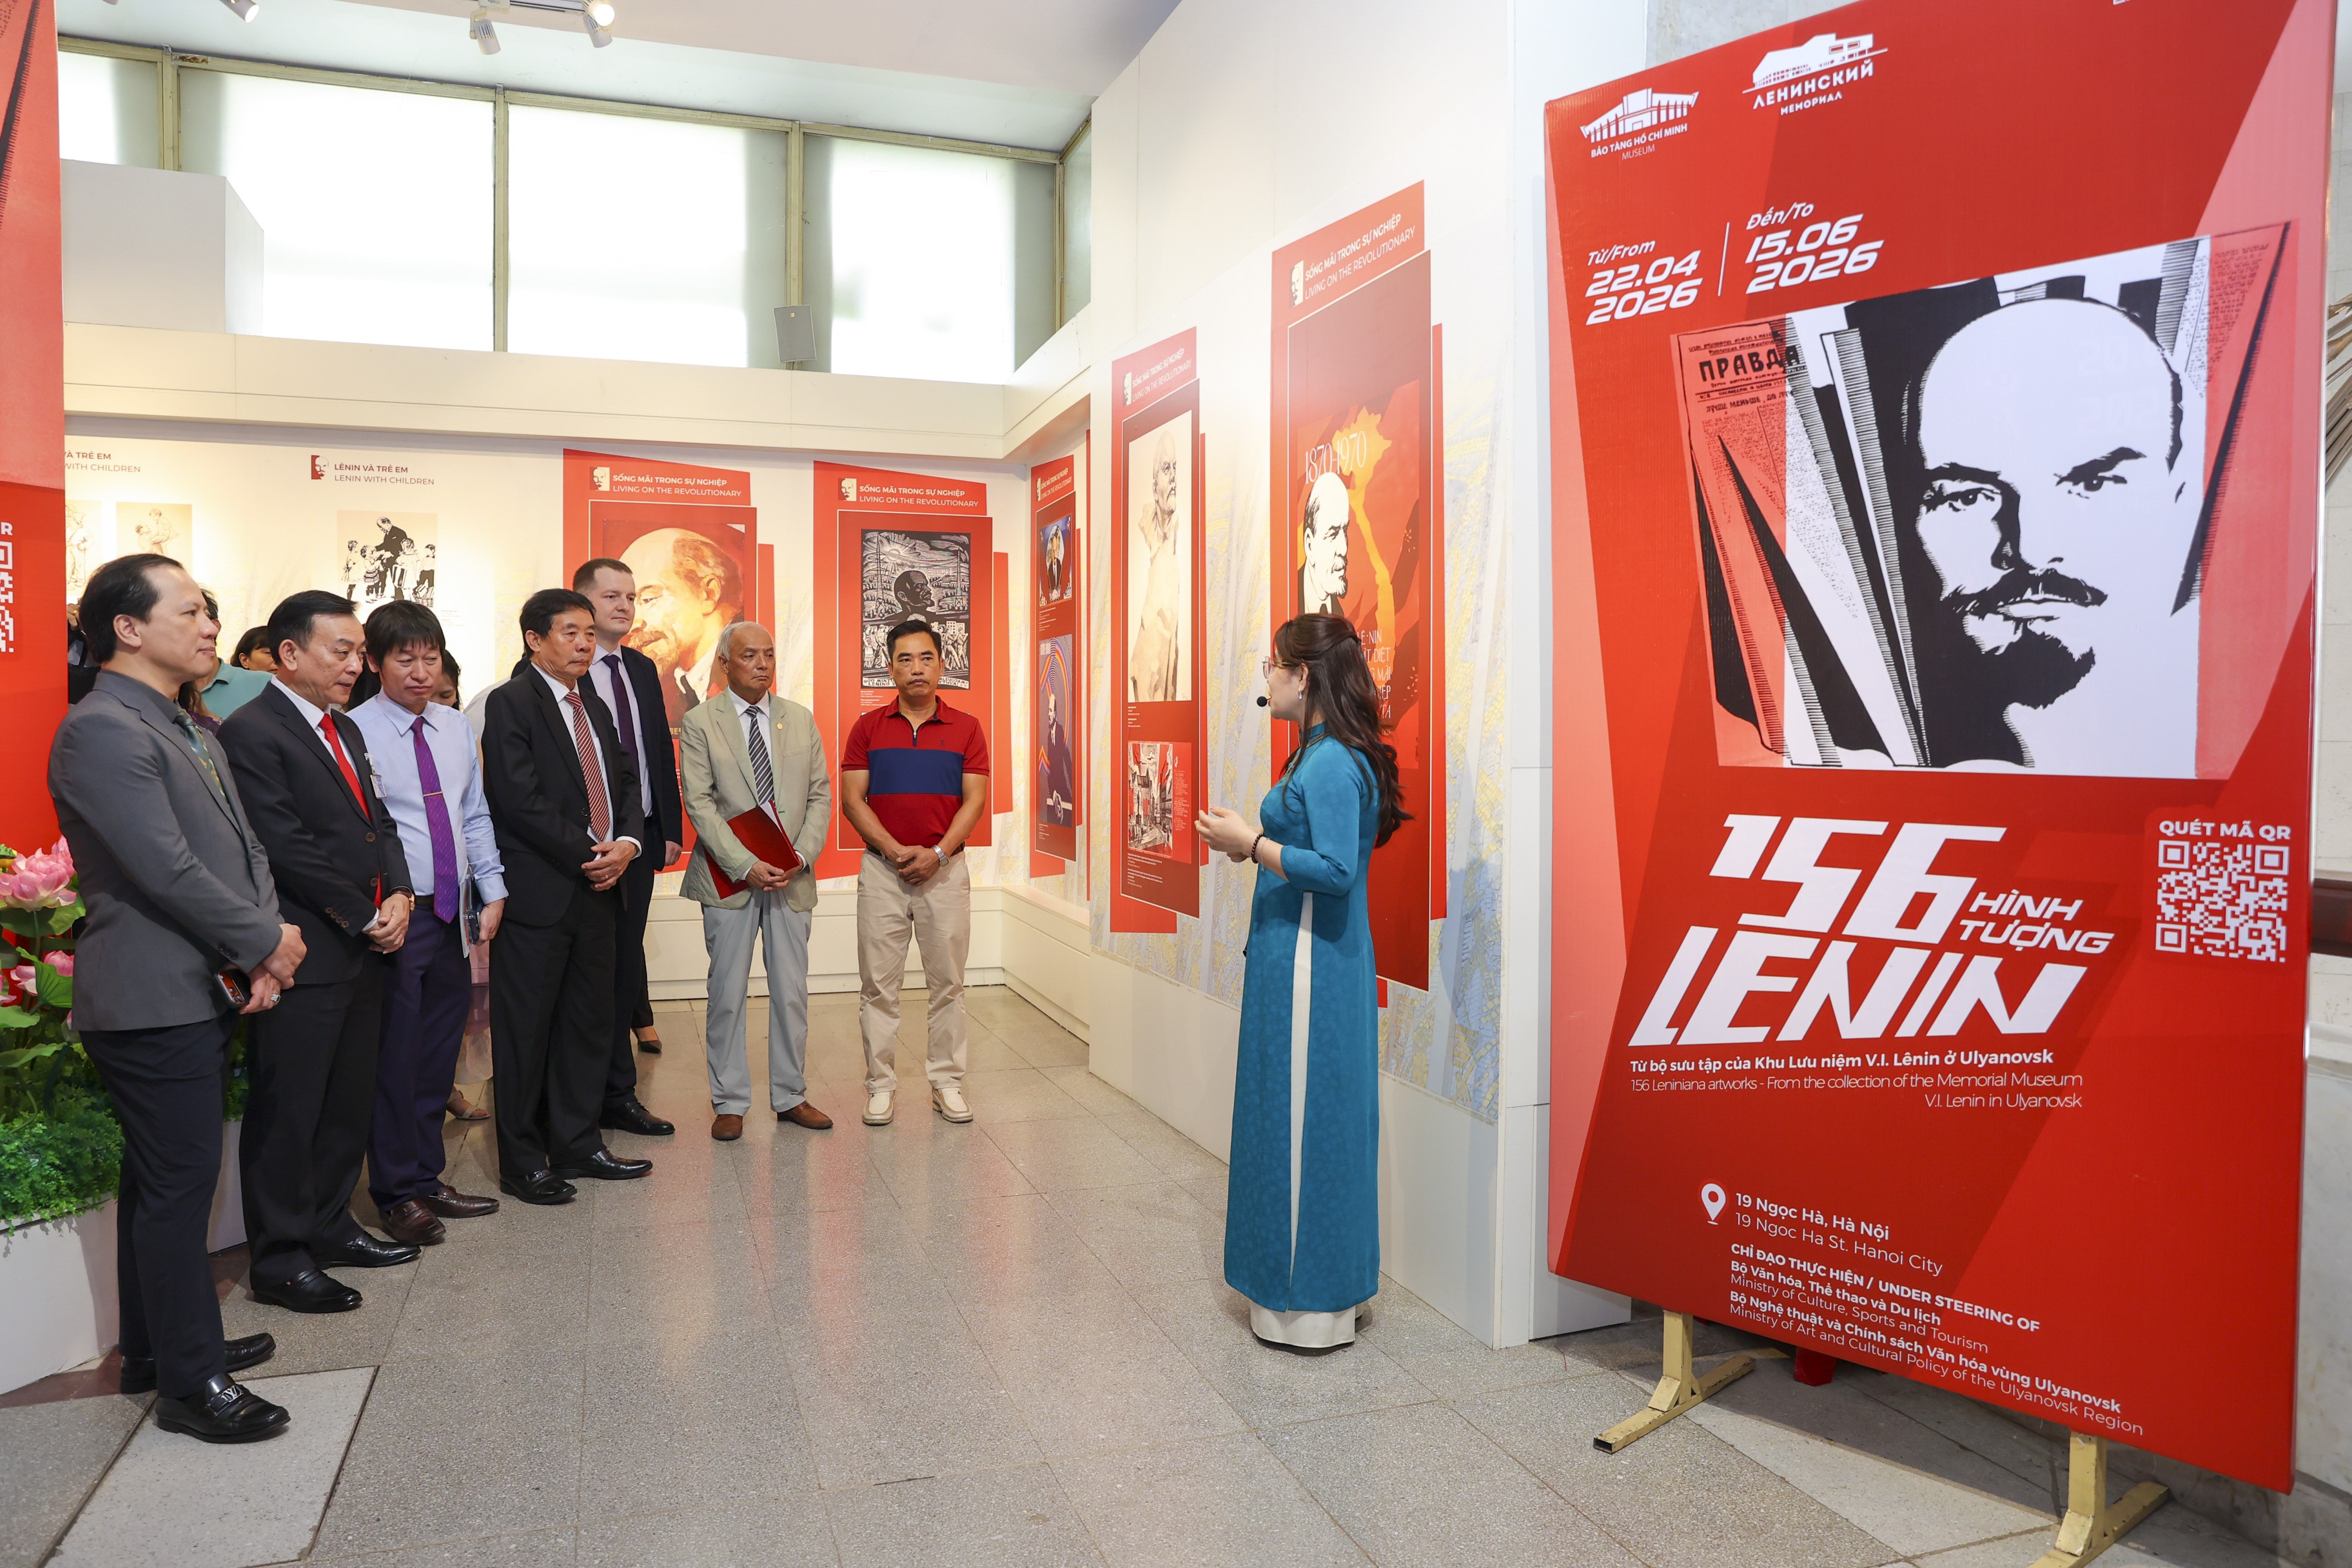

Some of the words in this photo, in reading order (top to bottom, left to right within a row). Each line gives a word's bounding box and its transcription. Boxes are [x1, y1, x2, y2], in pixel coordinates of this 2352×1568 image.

[1752, 59, 1874, 110] ЛЕНИНСКИЙ
[1780, 91, 1843, 116] МЕМОРИАЛ
[1591, 142, 1609, 158] BẢO
[1610, 136, 1632, 153] TÀNG
[1647, 127, 1663, 144] CHÍ
[1664, 122, 1688, 141] MINH
[1622, 144, 1656, 161] MUSEUM
[1745, 202, 1814, 230] Đến/To
[1586, 239, 1656, 267] Từ/From
[1745, 213, 1864, 264] 15.06
[1305, 279, 1326, 300] LIVING
[1327, 273, 1337, 286] ON
[1338, 264, 1352, 280] THE
[1353, 225, 1416, 272] REVOLUTIONARY
[1585, 250, 1701, 297] 22.04
[1745, 240, 1885, 295] 2026
[1585, 278, 1703, 326] 2026
[90, 464, 141, 473] CHILDREN
[334, 462, 360, 471] LÊNIN
[362, 464, 375, 472] VÀ
[377, 464, 393, 473] TRẺ
[1305, 430, 1367, 484] 1870-1970
[389, 476, 435, 485] CHILDREN
[612, 472, 636, 483] SỐNG
[638, 474, 653, 483] MÃI
[654, 476, 683, 484] TRONG
[684, 476, 696, 487] SỰ
[696, 477, 727, 487] NGHIỆP
[674, 487, 742, 497] REVOLUTIONARY
[859, 484, 881, 494] SỐNG
[882, 484, 897, 494] MÃI
[925, 487, 936, 497] SỰ
[937, 488, 965, 498] NGHIỆP
[916, 498, 979, 507] REVOLUTIONARY
[2159, 818, 2215, 837] QUÉT
[2220, 820, 2255, 838] MÃ
[2259, 825, 2291, 841] QR
[1968, 888, 2084, 922] HÌNH
[1958, 918, 2116, 955] TƯỢNG
[1630, 1059, 1649, 1072] Từ
[1650, 1058, 1667, 1075] bộ
[1670, 1060, 1696, 1072] sưu
[1698, 1057, 1722, 1074] tập
[1723, 1055, 1751, 1070] của
[1754, 1055, 1785, 1070] Khu
[1789, 1056, 1818, 1068] Lưu
[1821, 1054, 1862, 1071] niệm
[1865, 1054, 1889, 1066] V.I.
[1893, 1051, 1940, 1066] Lênin
[1944, 1050, 1956, 1065] ở
[1960, 1048, 2054, 1068] Ulyanovsk
[1631, 1079, 1650, 1092] 156
[1652, 1078, 1706, 1091] Leniniana
[1708, 1077, 1758, 1090] artworks
[1767, 1076, 1801, 1089] From
[1803, 1075, 1825, 1088] the
[1827, 1074, 1890, 1089] collection
[1893, 1073, 1909, 1088] of
[1910, 1073, 1934, 1087] the
[1937, 1072, 2006, 1087] Memorial
[2011, 1072, 2083, 1086] Museum
[1925, 1094, 1943, 1108] V.I.
[1946, 1093, 1985, 1108] Lenin
[1989, 1093, 2002, 1107] in
[2006, 1093, 2082, 1110] Ulyanovsk
[1735, 1192, 1752, 1208] 19
[1756, 1197, 1798, 1219] Ngọc
[1802, 1208, 1828, 1228] Hà,
[1832, 1215, 1856, 1233] Hà
[1859, 1221, 1890, 1242] Nội
[1735, 1212, 1751, 1228] 19
[1756, 1217, 1797, 1239] Ngoc
[1802, 1228, 1824, 1246] Ha
[1828, 1235, 1848, 1252] St.
[1854, 1240, 1904, 1265] Hanoi
[1908, 1254, 1943, 1277] City
[1730, 1243, 1754, 1258] CHỈ
[1756, 1250, 1786, 1266] ĐẠO
[1788, 1257, 1827, 1277] THỰC
[1829, 1268, 1864, 1288] HIỆN
[1878, 1279, 1932, 1304] UNDER
[1935, 1295, 2014, 1326] STEERING
[2017, 1317, 2040, 1332] OF
[1730, 1260, 1748, 1275] Bộ
[1750, 1265, 1775, 1281] Văn
[1778, 1272, 1806, 1290] hóa,
[1808, 1280, 1833, 1297] Thể
[1836, 1288, 1868, 1306] thao
[1870, 1296, 1887, 1311] và
[1890, 1302, 1910, 1317] Du
[1914, 1307, 1941, 1326] lịch
[1730, 1273, 1779, 1297] Ministry
[1782, 1288, 1795, 1300] of
[1798, 1292, 1848, 1316] Culture,
[1852, 1306, 1896, 1327] Sports
[1899, 1320, 1926, 1337] and
[1930, 1326, 1988, 1354] Tourism
[1730, 1290, 1747, 1305] Bộ
[1749, 1296, 1785, 1315] Nghệ
[1787, 1306, 1823, 1327] thuật
[1826, 1317, 1842, 1331] và
[1845, 1322, 1886, 1344] Chính
[1890, 1335, 1924, 1355] sách
[1926, 1344, 1955, 1364] Văn
[1959, 1354, 1988, 1373] hóa
[1991, 1365, 2031, 1388] vùng
[2035, 1377, 2121, 1414] Ulyanovsk
[1730, 1304, 1778, 1328] Ministry
[1781, 1319, 1794, 1331] of
[1796, 1324, 1816, 1338] Art
[1819, 1331, 1845, 1346] and
[1848, 1338, 1902, 1362] Cultural
[1906, 1353, 1948, 1378] Policy
[1952, 1369, 1968, 1381] of
[1971, 1372, 1996, 1389] the
[2001, 1380, 2078, 1416] Ulyanovsk
[2083, 1406, 2144, 1436] Region
